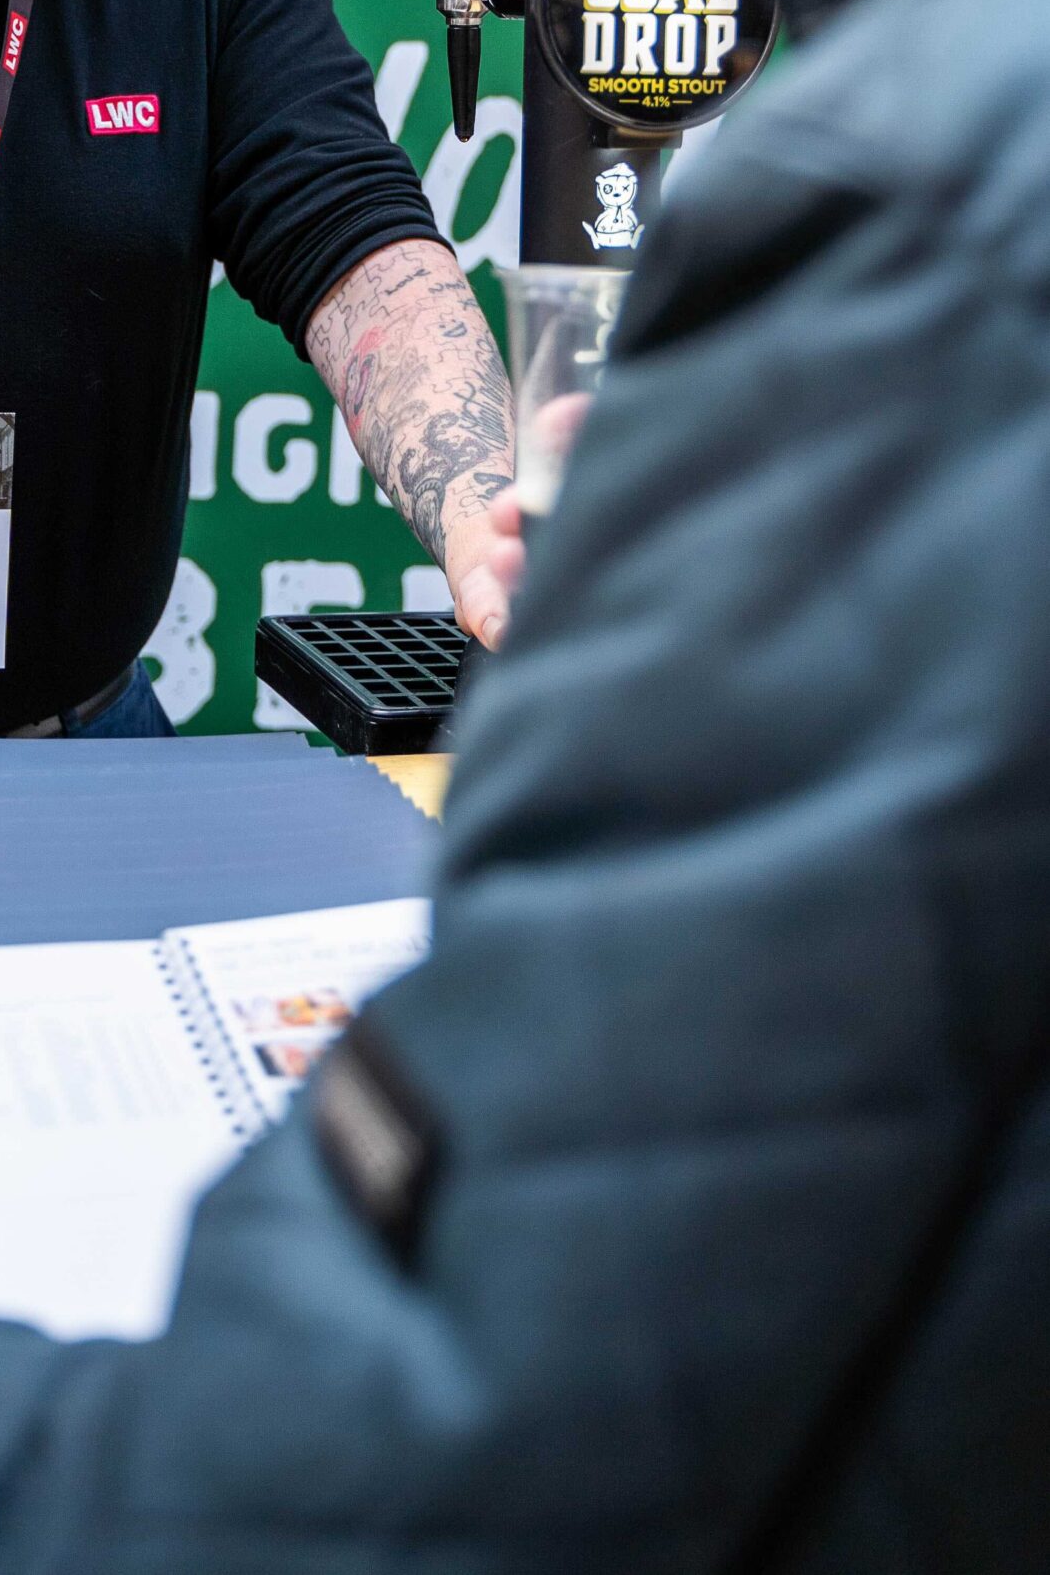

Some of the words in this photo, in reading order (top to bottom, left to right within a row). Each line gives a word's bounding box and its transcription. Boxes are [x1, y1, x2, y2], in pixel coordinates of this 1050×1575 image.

[5, 18, 25, 71] LWC
[580, 11, 738, 76] DROP
[588, 78, 664, 94] SMOOTH
[667, 78, 726, 95] STOUT
[91, 101, 155, 129] LWC
[641, 95, 671, 108] 4.1%
